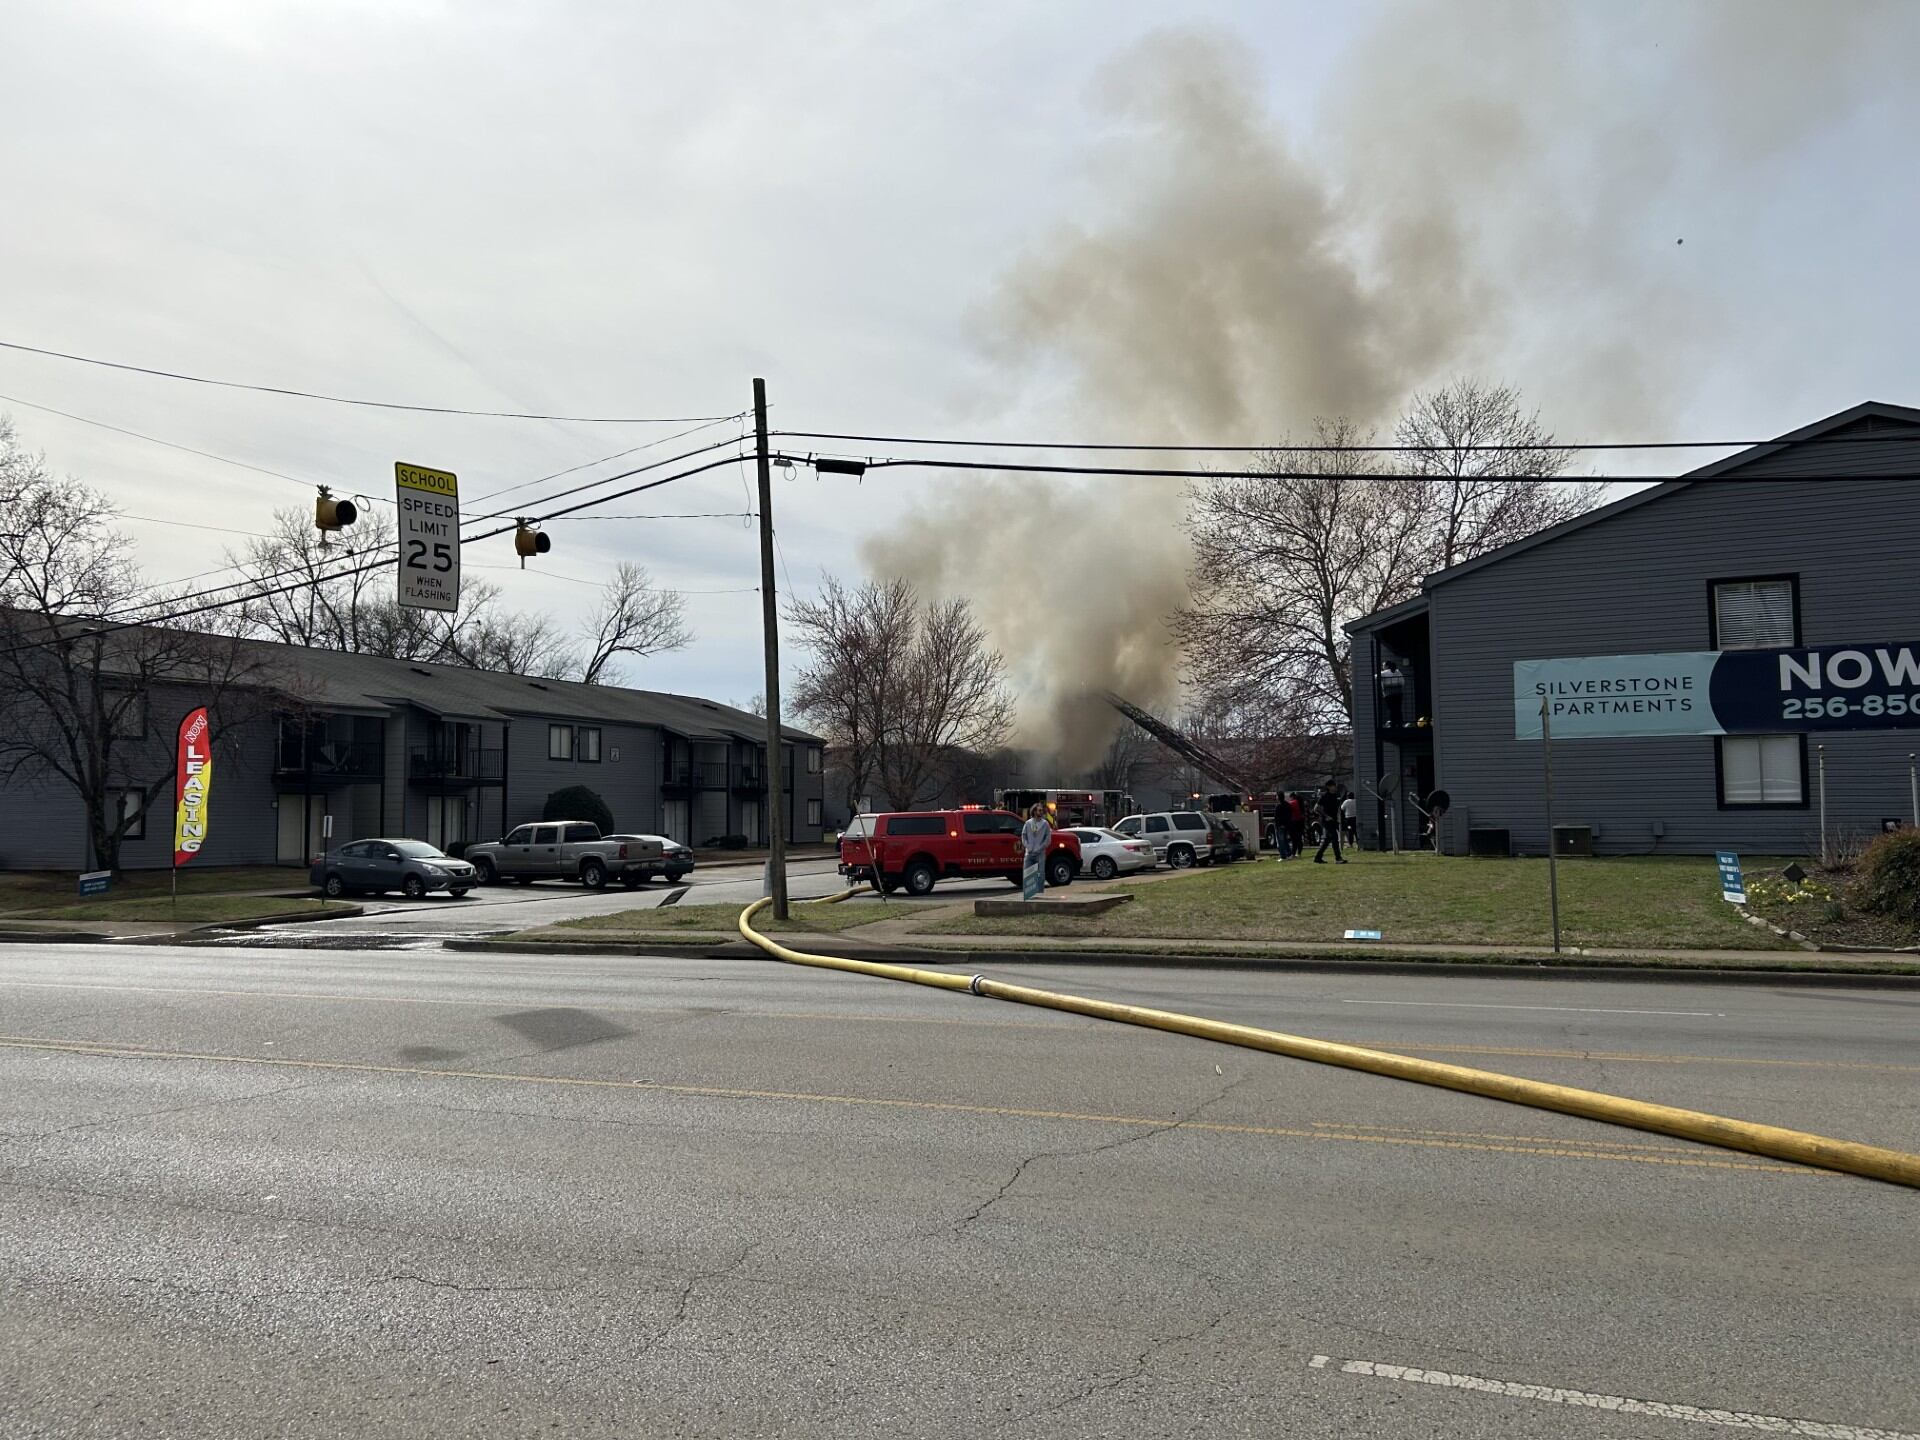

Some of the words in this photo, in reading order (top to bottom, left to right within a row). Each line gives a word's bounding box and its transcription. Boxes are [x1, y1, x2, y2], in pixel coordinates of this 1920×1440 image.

[400, 469, 454, 492] SCHOOL
[403, 497, 453, 518] SPEED
[409, 519, 449, 537] LIMIT
[407, 540, 452, 573] 25
[416, 576, 442, 588] WHEN
[405, 587, 452, 602] FLASHING
[1778, 648, 1920, 691] NOW
[1535, 676, 1694, 696] SILVERSTONE
[184, 715, 208, 744] NOW
[180, 745, 204, 853] LEASING
